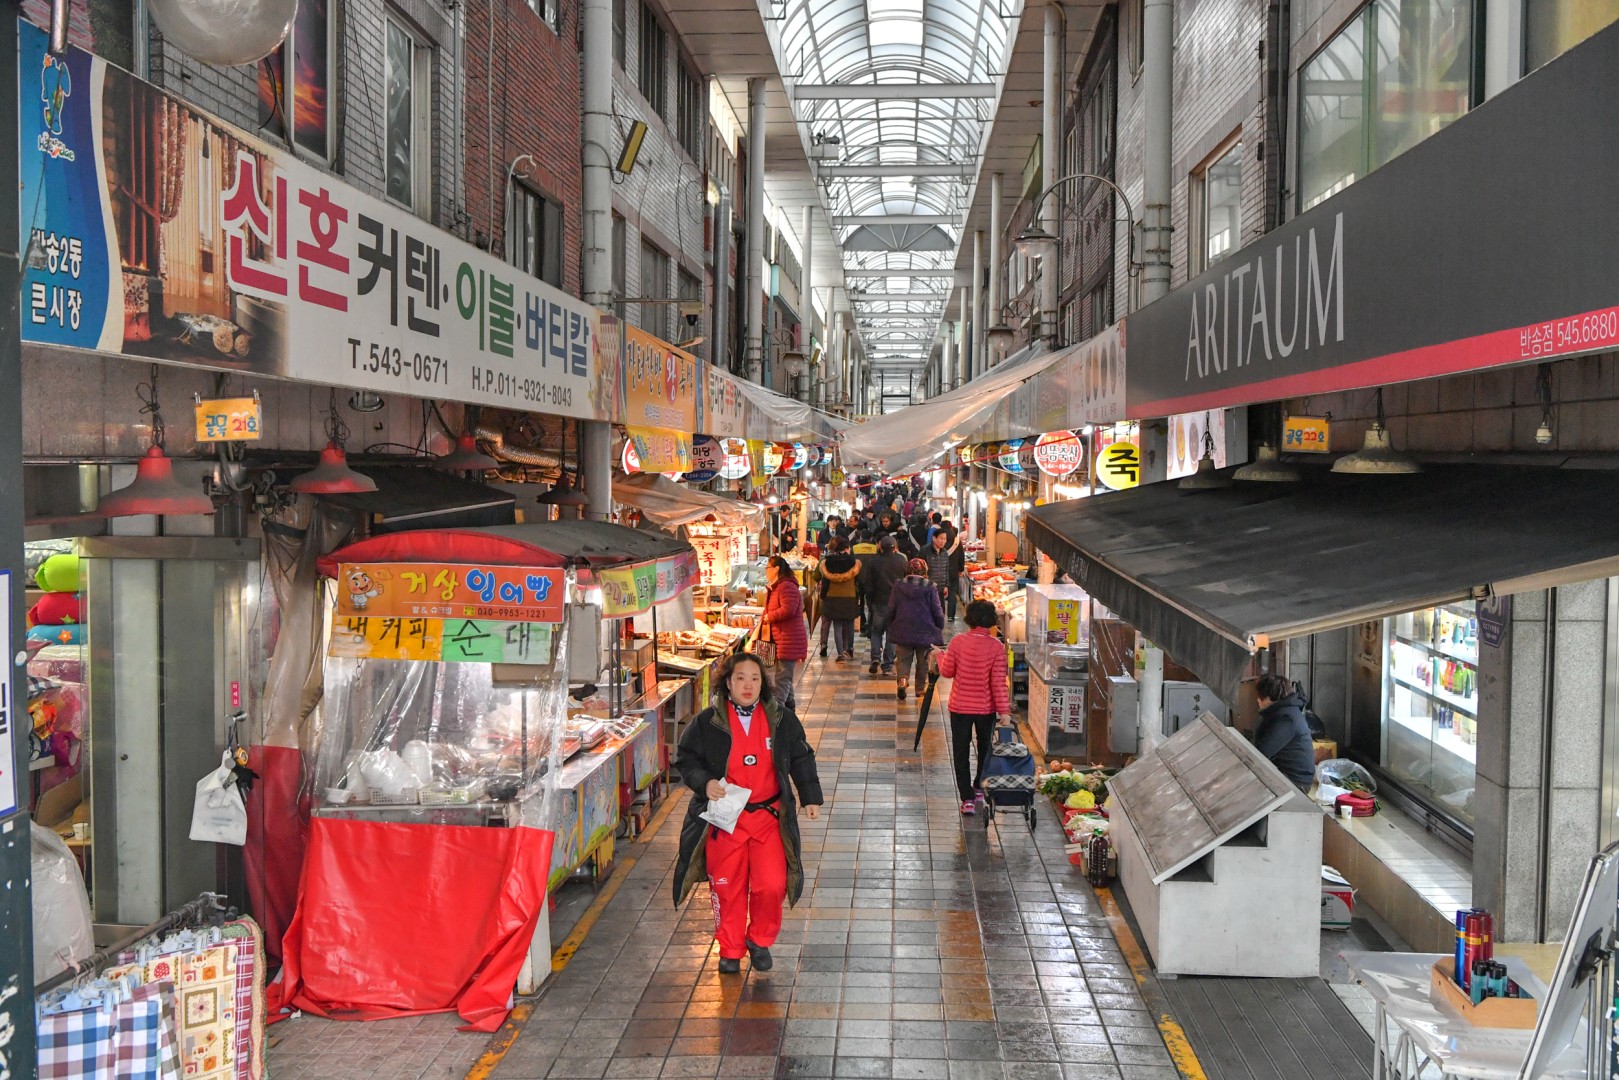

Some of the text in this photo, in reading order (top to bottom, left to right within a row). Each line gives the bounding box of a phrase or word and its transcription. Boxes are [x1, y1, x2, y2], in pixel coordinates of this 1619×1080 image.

[1185, 211, 1344, 382] ARITAUM
[1520, 311, 1617, 357] 반송점 545.6880
[347, 337, 449, 385] T.543-0671
[206, 414, 258, 438] 골목 21호
[400, 568, 553, 605] 거상 잉어빵
